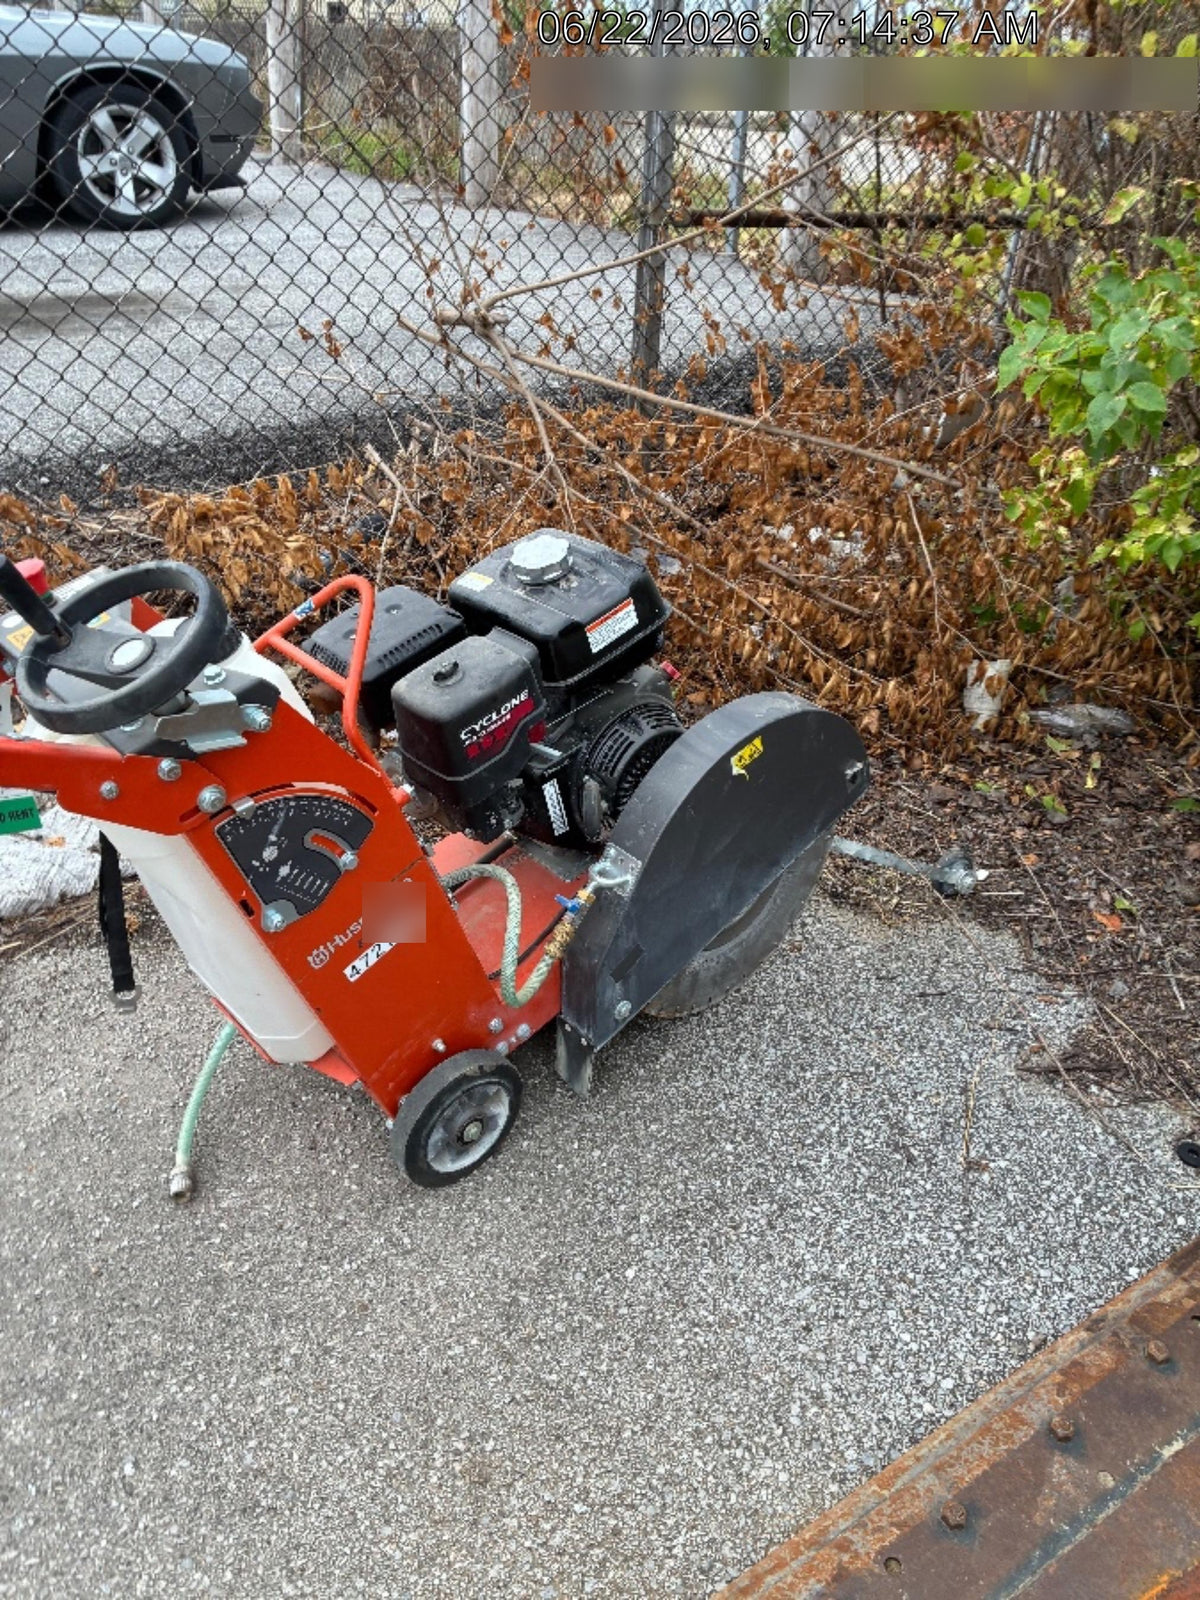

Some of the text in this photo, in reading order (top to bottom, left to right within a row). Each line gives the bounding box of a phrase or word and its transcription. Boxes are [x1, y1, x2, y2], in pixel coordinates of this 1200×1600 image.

[460, 689, 529, 740] CYCLONE
[326, 917, 363, 953] Hus
[349, 942, 394, 979] 472
